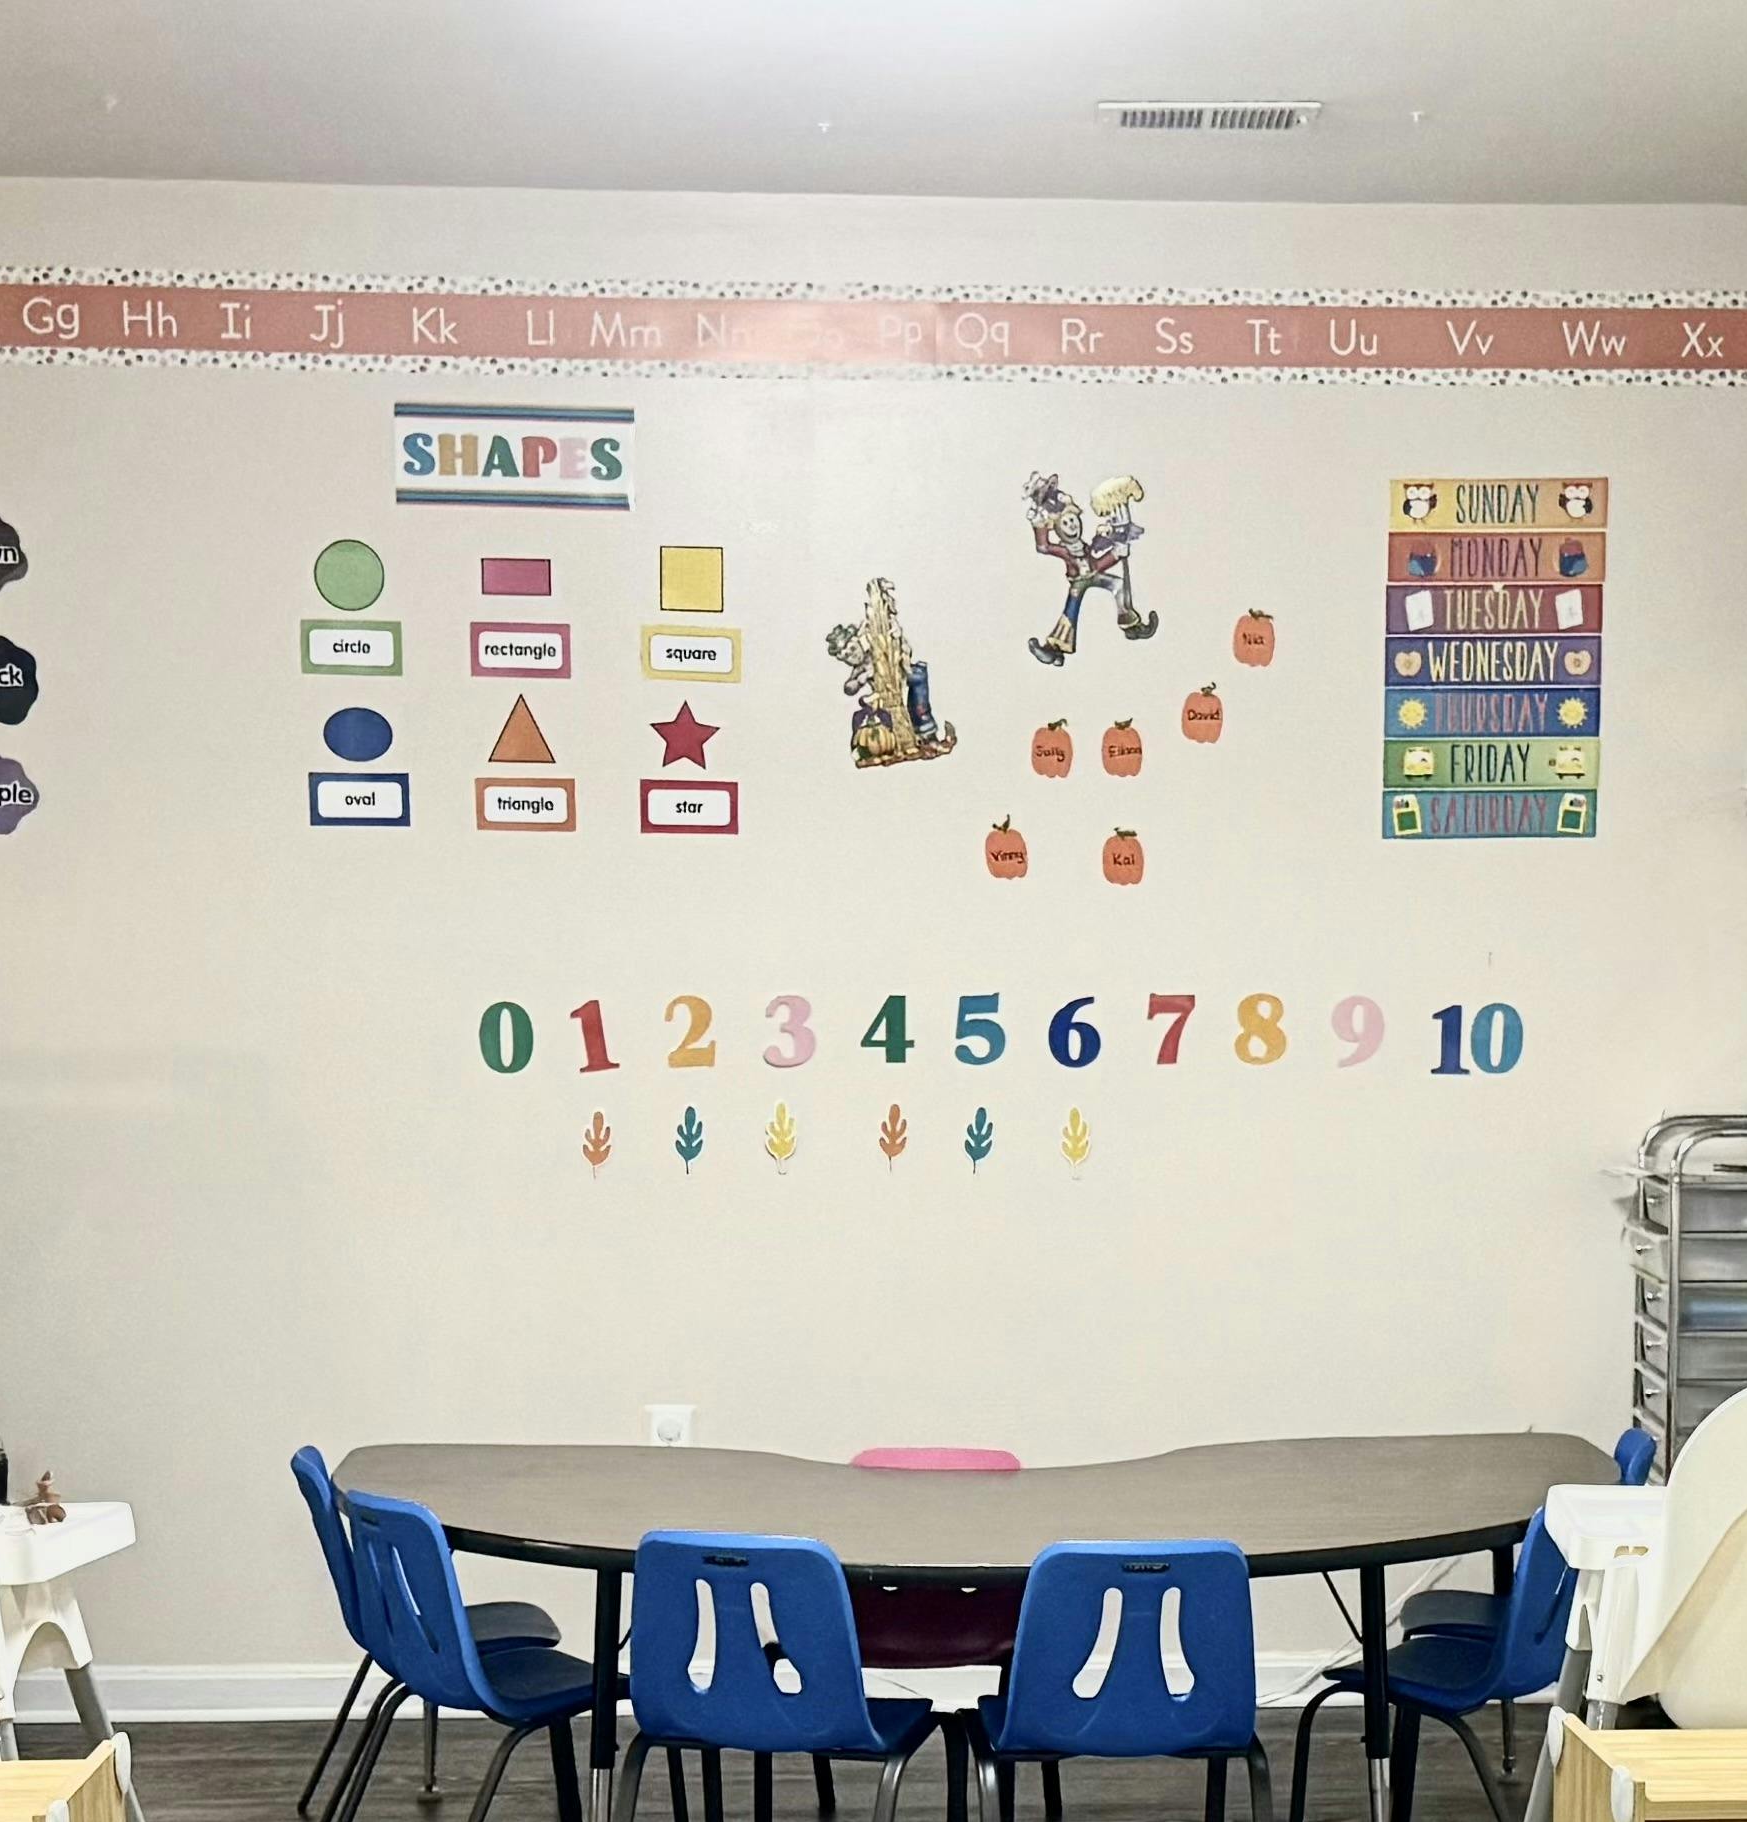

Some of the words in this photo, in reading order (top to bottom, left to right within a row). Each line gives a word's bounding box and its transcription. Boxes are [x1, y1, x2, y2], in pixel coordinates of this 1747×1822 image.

[24, 297, 81, 340] Gg
[123, 300, 178, 338] Hh
[221, 302, 252, 340] Ii
[310, 305, 346, 349] Jj
[413, 308, 459, 345] Kk
[527, 310, 555, 346] Ll
[591, 312, 662, 348] Mm
[878, 314, 922, 355] Pp
[955, 313, 1011, 357] Qq
[1062, 318, 1104, 354] Rr
[1156, 319, 1194, 357] Ss
[1247, 319, 1281, 356] Tt
[1330, 320, 1379, 357] Uu
[1448, 320, 1493, 356] Vv
[1563, 323, 1627, 359] Ww
[1683, 322, 1724, 360] Xx
[403, 432, 623, 481] SHAPES
[1456, 484, 1539, 523] SUNDAY
[1450, 538, 1544, 578] MONDAY
[1443, 589, 1544, 630] TUESDAY
[333, 639, 370, 655] circle
[485, 642, 556, 660] rectangle
[666, 646, 717, 664] square
[1428, 641, 1559, 682] WEDNESDAY
[1187, 709, 1221, 721] David
[1434, 693, 1549, 733] THURSDAY
[1035, 745, 1066, 763] Sally
[1450, 744, 1530, 783] FRIDAY
[345, 791, 376, 807] oval
[497, 796, 554, 813] triangle
[676, 799, 703, 815] star
[1429, 795, 1548, 834] SATURDAY
[991, 850, 1024, 863] Vinny
[478, 1001, 534, 1074] 0
[569, 1000, 620, 1073] 1
[665, 995, 716, 1068] 2
[762, 995, 817, 1068] 3
[860, 995, 915, 1064] 4
[953, 993, 1006, 1066] 5
[1047, 996, 1101, 1068] 6
[1146, 994, 1196, 1065] 7
[1234, 993, 1287, 1066] 8
[1331, 995, 1385, 1068] 9
[1429, 1002, 1524, 1076] 10
